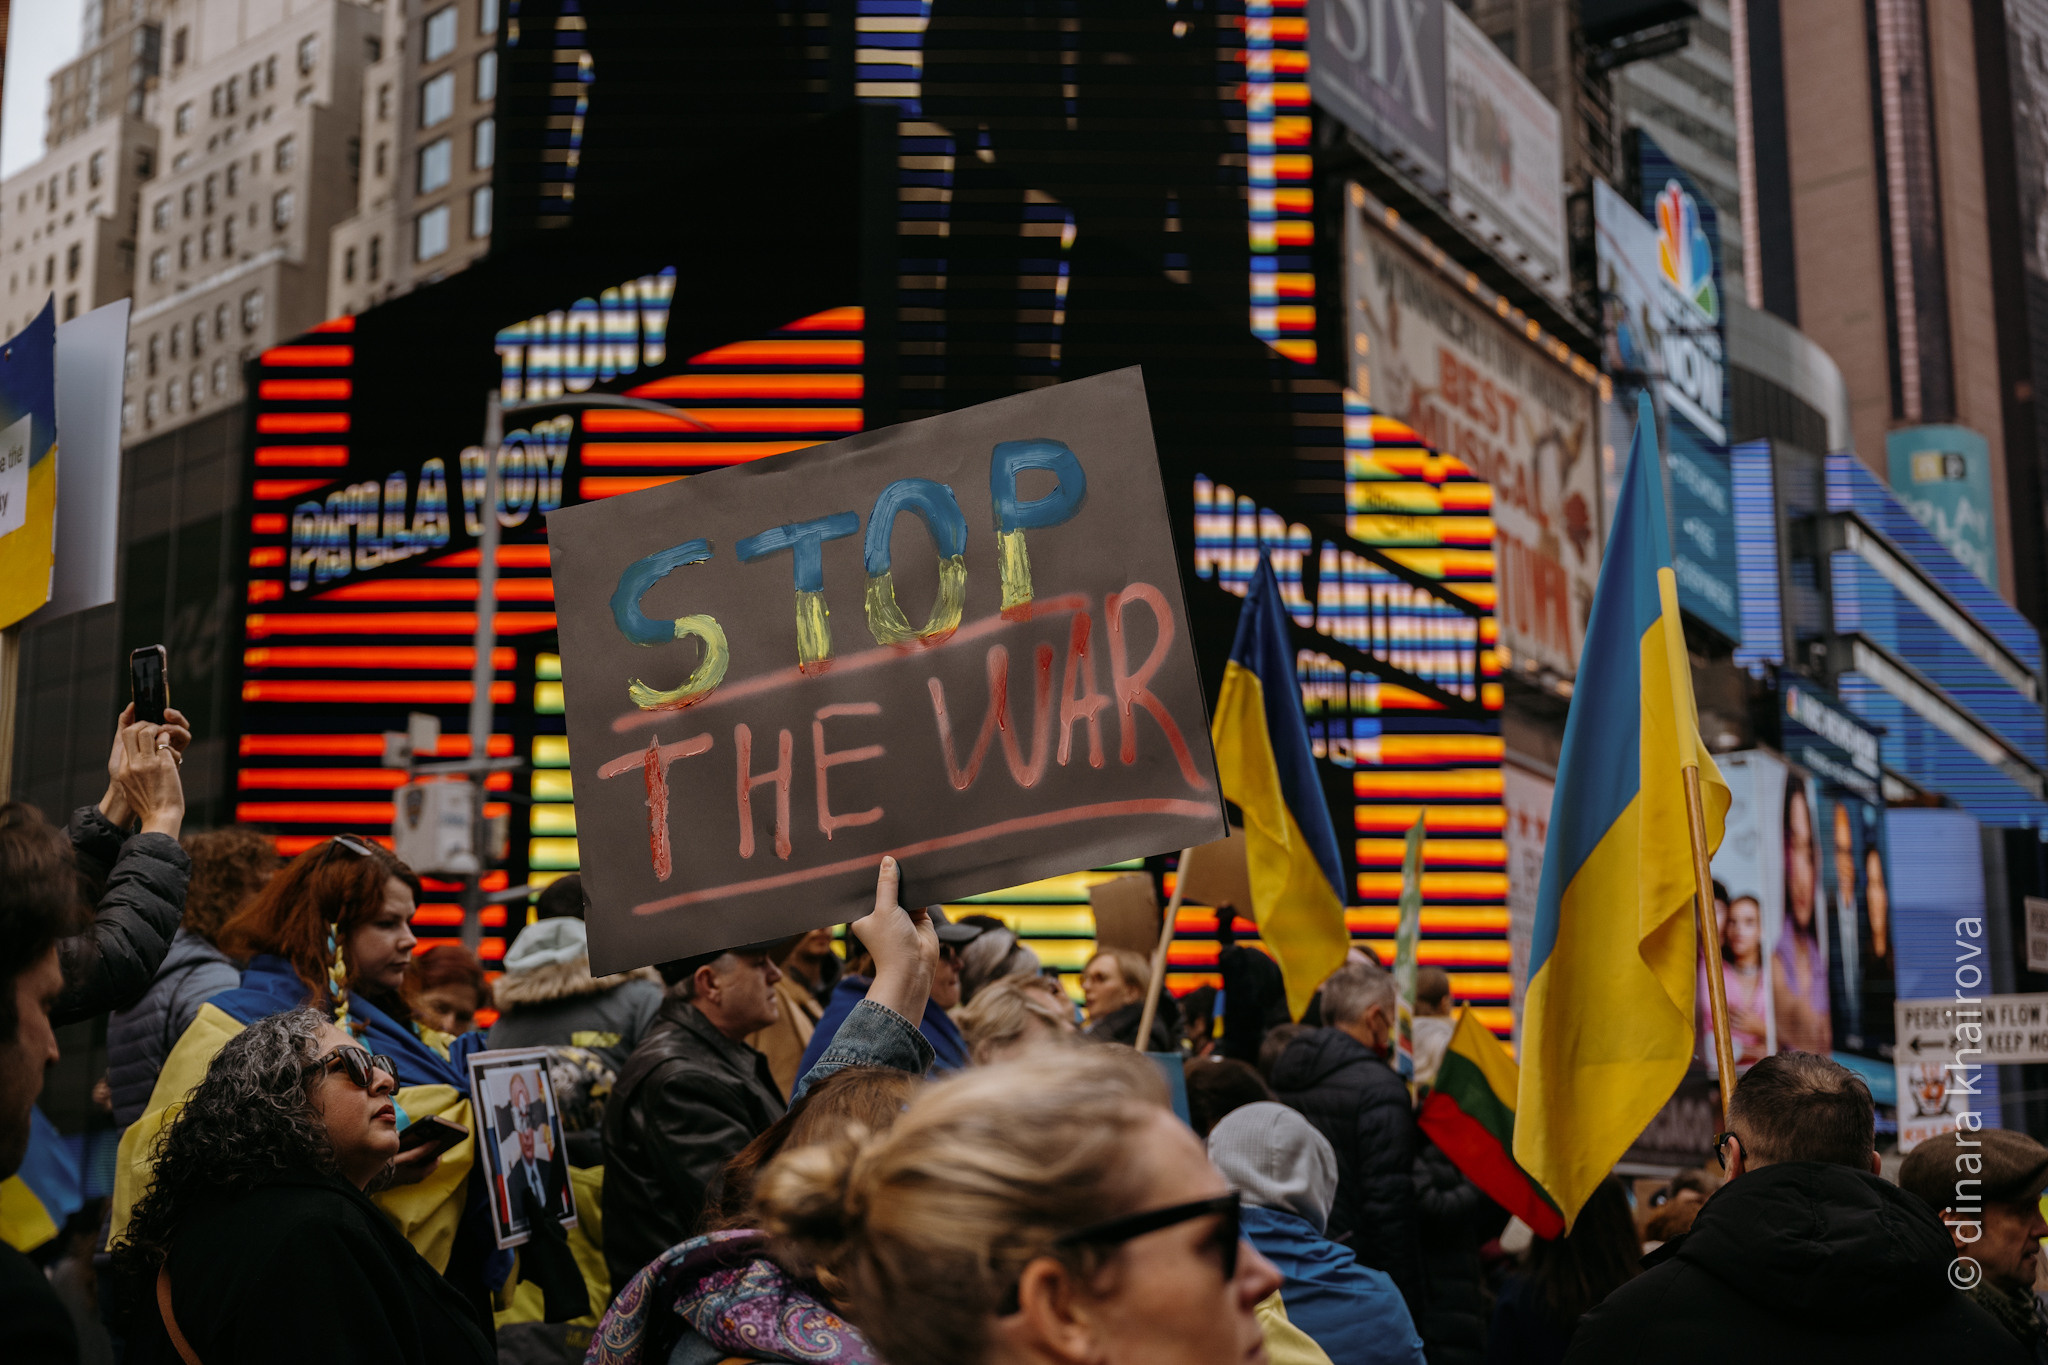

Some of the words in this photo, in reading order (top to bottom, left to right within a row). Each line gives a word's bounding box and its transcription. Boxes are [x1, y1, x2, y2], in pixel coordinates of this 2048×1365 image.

[1439, 346, 1519, 447] BEST
[610, 438, 1087, 711] STOP
[597, 701, 885, 882] THE
[928, 581, 1212, 792] WAR
[1986, 1030, 2024, 1055] KEEP
[2001, 1004, 2041, 1028] FLOW
